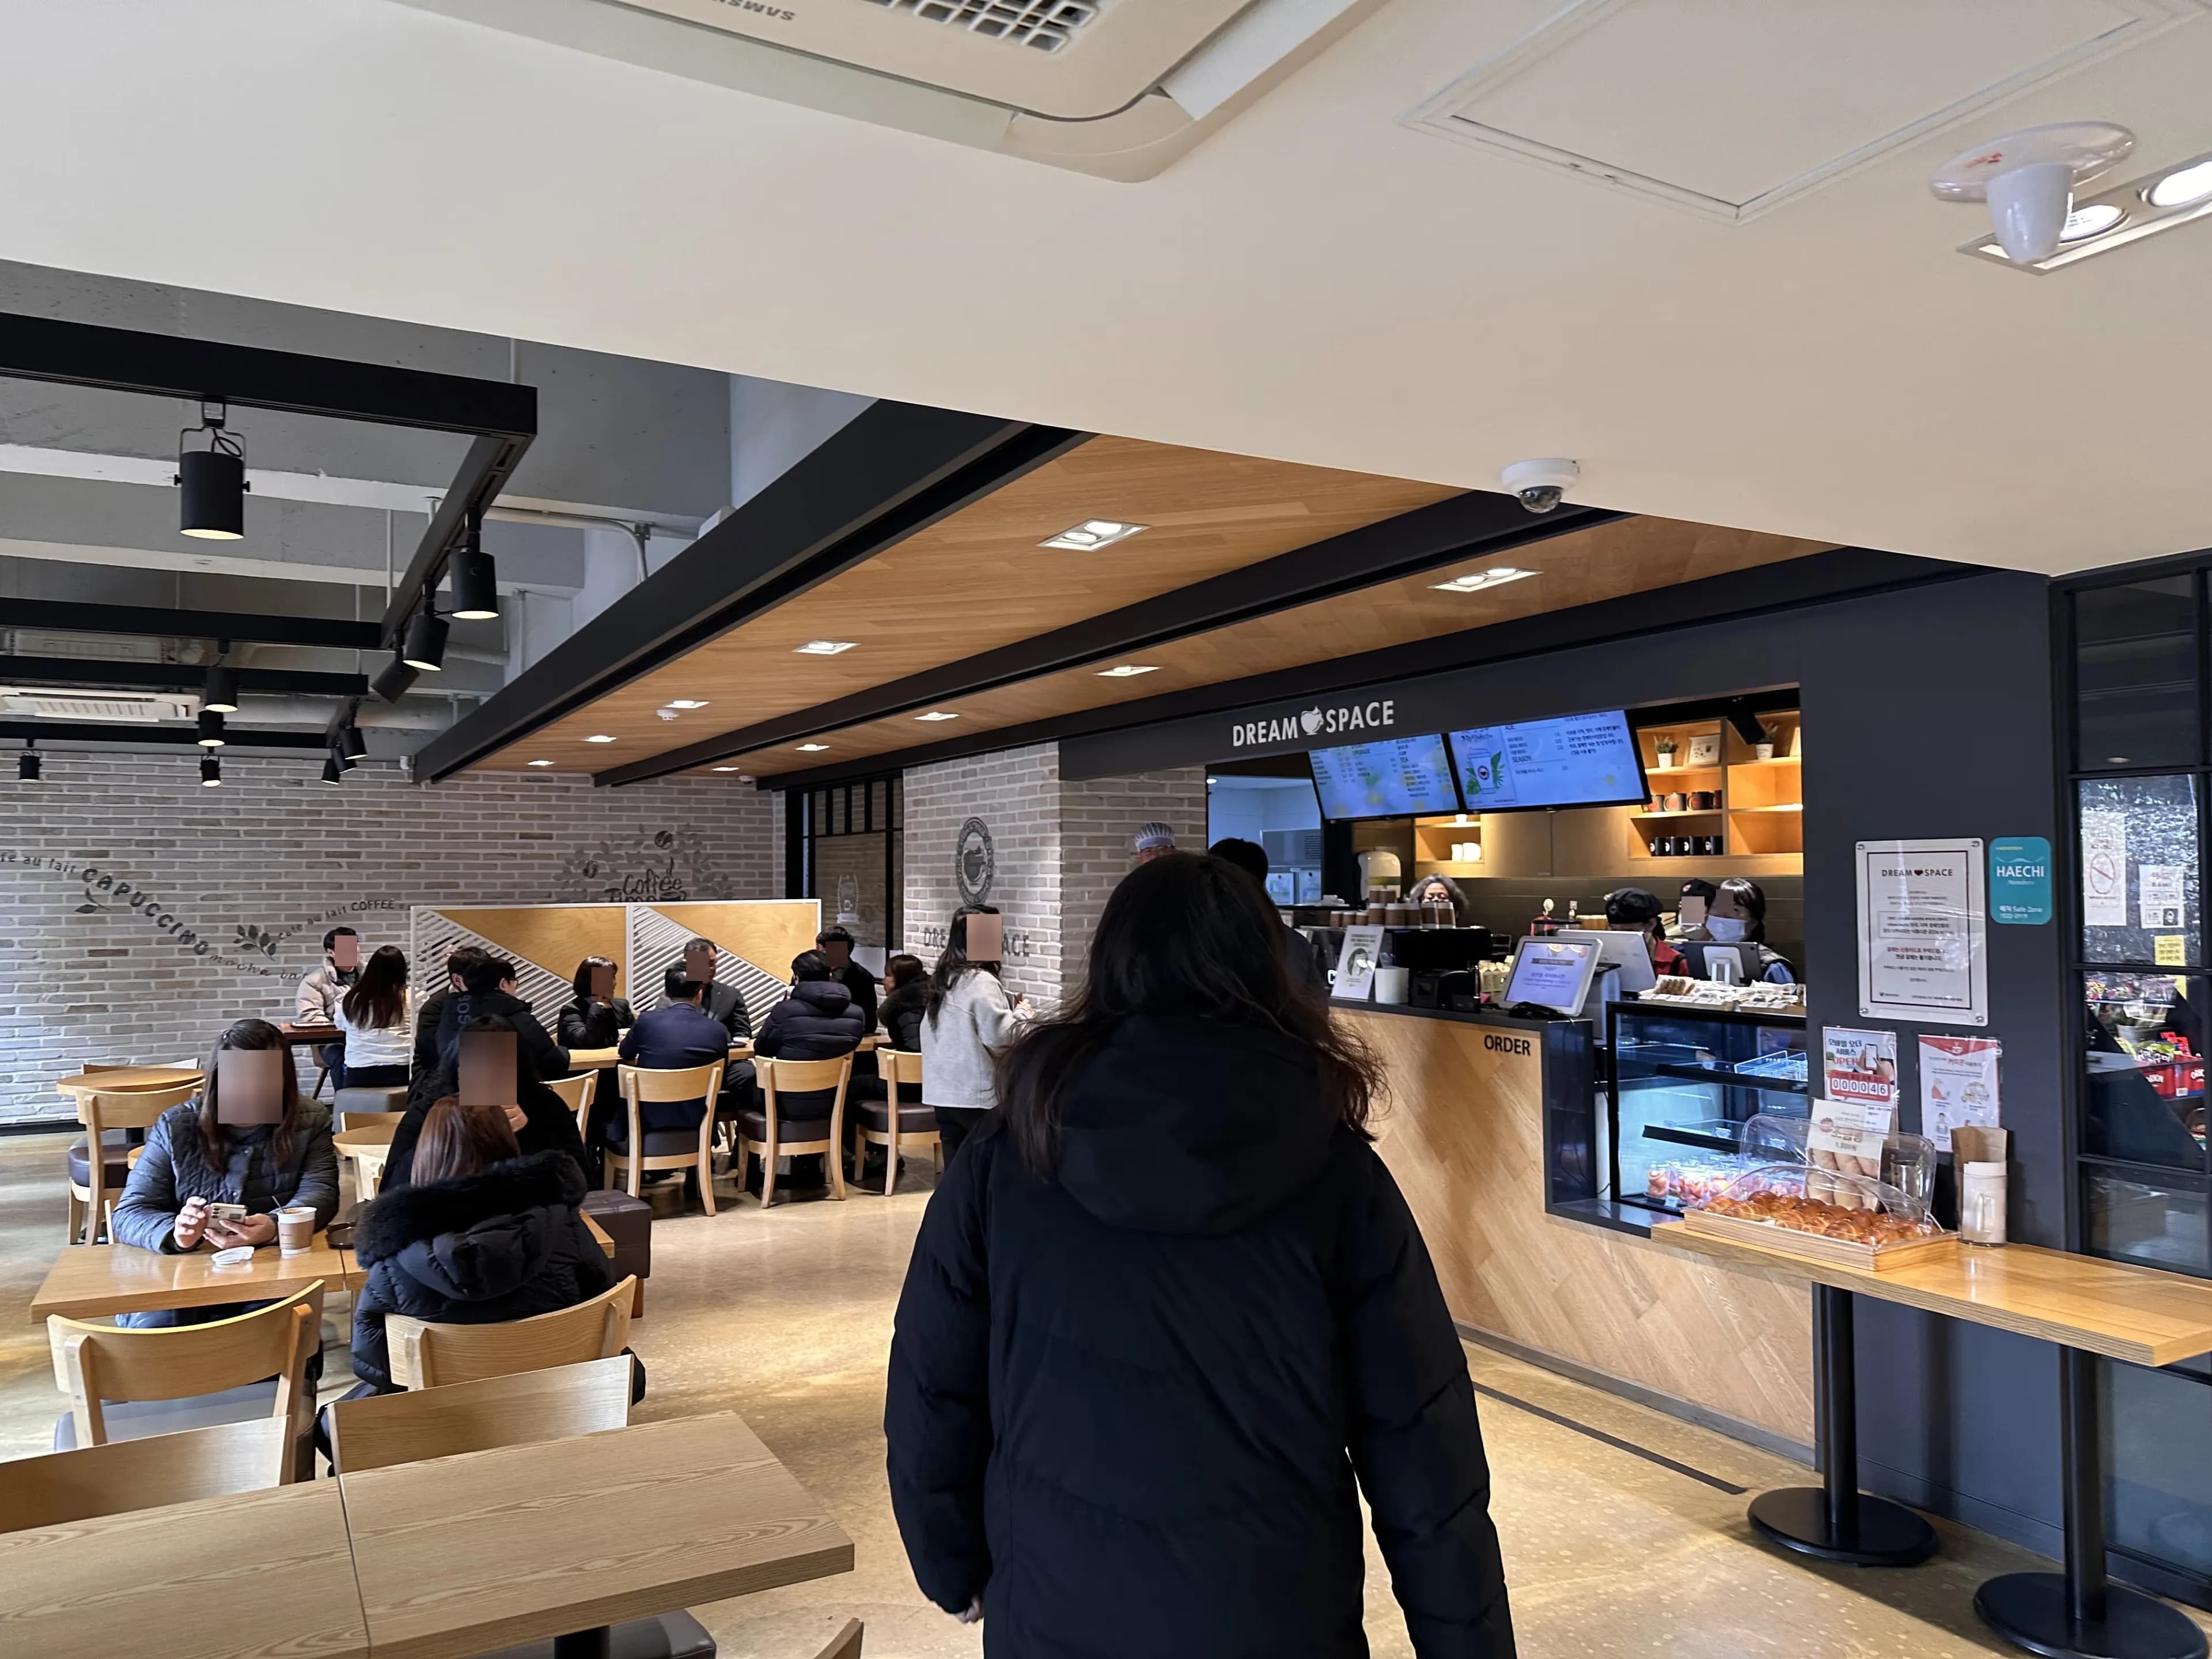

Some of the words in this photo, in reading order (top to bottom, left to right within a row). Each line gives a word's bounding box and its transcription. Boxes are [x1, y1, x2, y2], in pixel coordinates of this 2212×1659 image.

[713, 0, 796, 21] SAMS
[1232, 721, 1298, 747] DREAM
[1325, 700, 1394, 733] SPACE
[1925, 869, 1953, 877] SPACE
[1996, 865, 2044, 878] HAECHI
[622, 868, 683, 895] Coffee
[351, 899, 395, 911] COFFEE
[22, 856, 41, 866] au
[82, 868, 209, 956] CAPUCCINO
[209, 954, 272, 976] mocha
[924, 926, 946, 949] DRE
[1484, 1034, 1531, 1056] ORDER
[1828, 1038, 1847, 1048] 모바일
[1849, 1039, 1862, 1048] 오더
[1836, 1047, 1857, 1056] 서비스
[1833, 1056, 1859, 1066] OPEN
[1832, 1078, 1887, 1095] 000046
